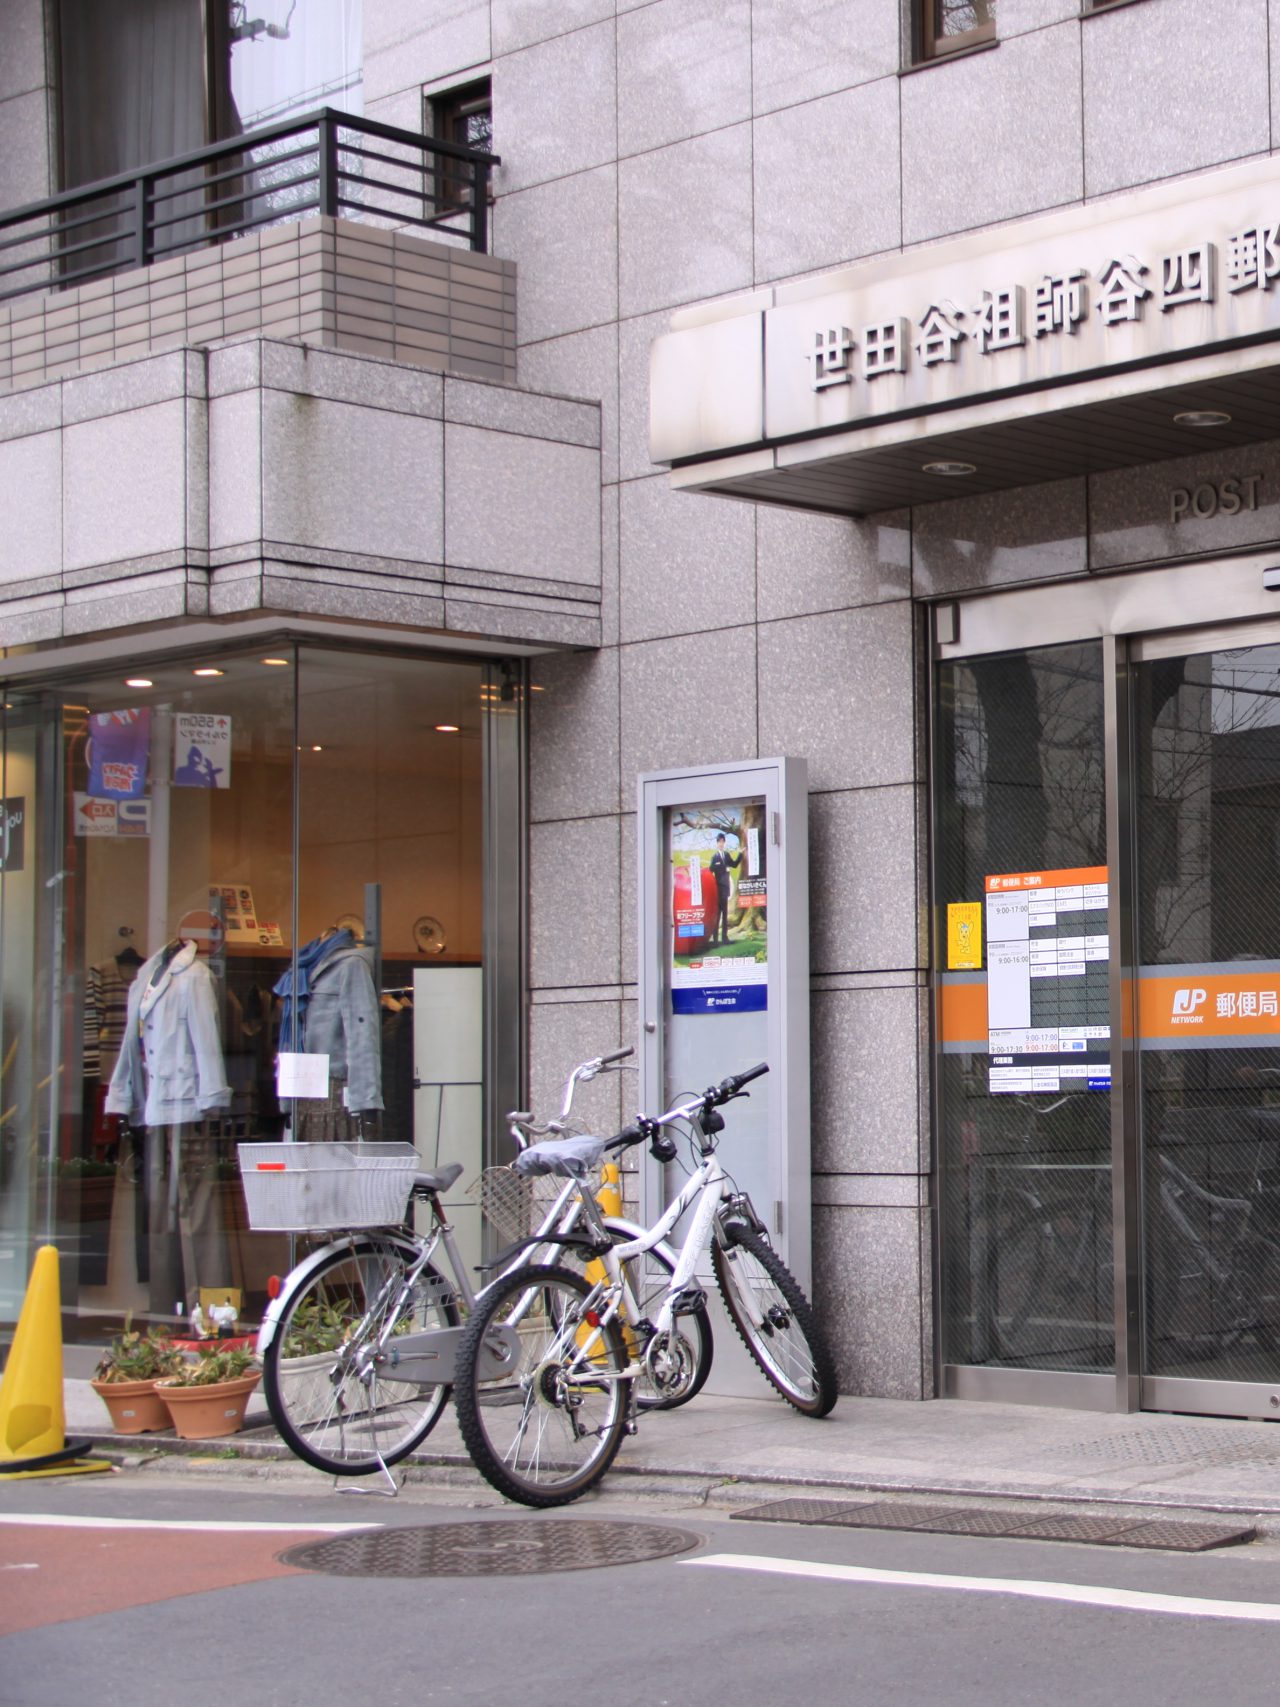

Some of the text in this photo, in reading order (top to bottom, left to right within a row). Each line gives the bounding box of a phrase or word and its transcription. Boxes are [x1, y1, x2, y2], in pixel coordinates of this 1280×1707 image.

[1169, 473, 1264, 523] POST
[1172, 988, 1278, 1018] JP 郵便局
[1171, 1015, 1204, 1024] NETWORK
